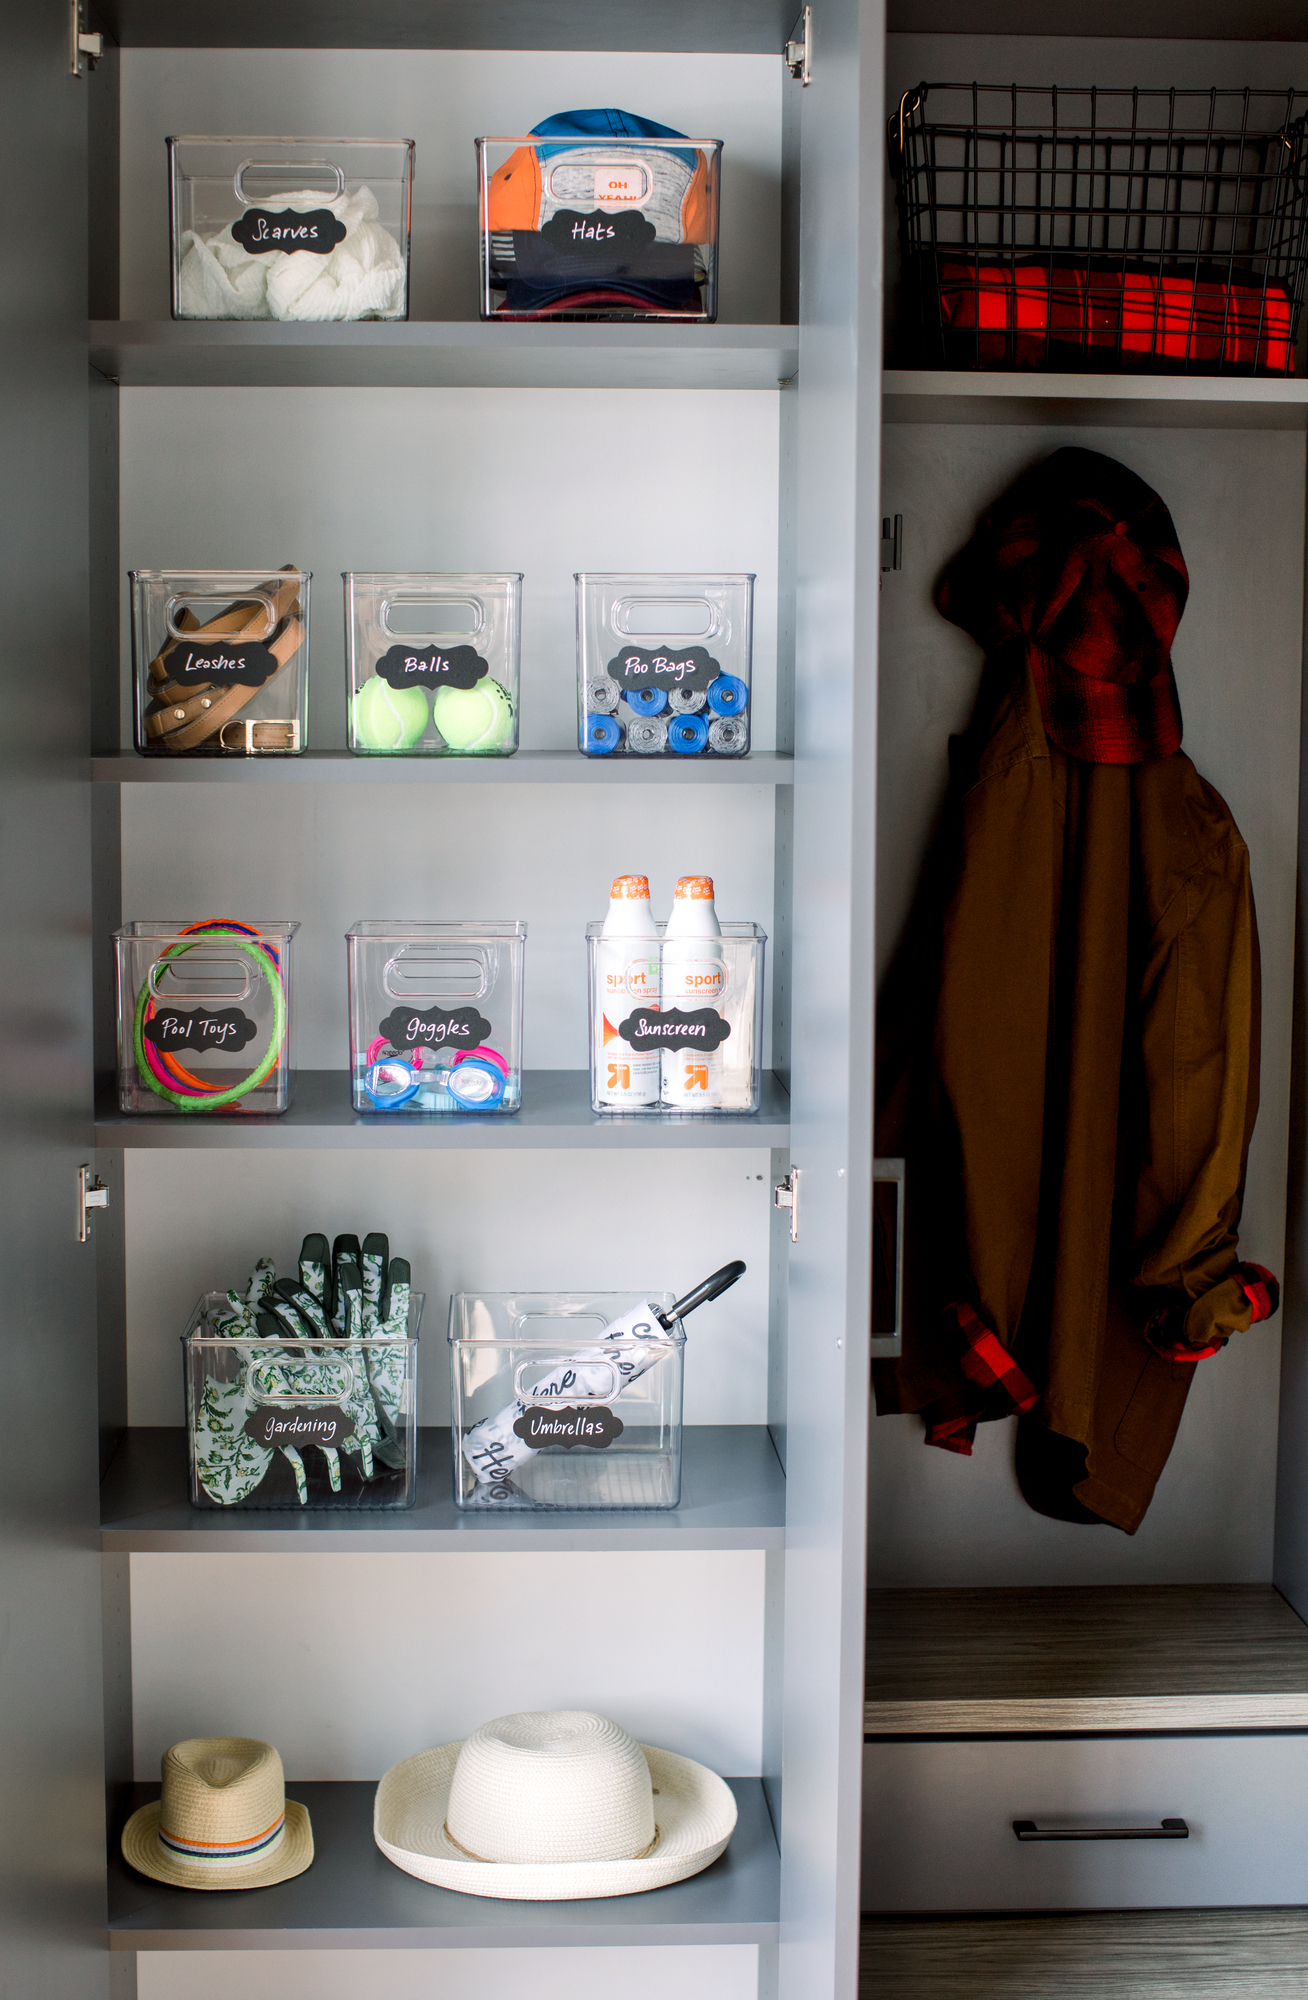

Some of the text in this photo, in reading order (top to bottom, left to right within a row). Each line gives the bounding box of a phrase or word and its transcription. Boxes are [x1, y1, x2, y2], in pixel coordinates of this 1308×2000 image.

[608, 181, 628, 189] OH
[252, 219, 319, 241] Scarves
[571, 220, 616, 241] Hats
[185, 653, 246, 672] Leashes
[404, 656, 450, 673] Balls
[625, 656, 696, 681] Poo Bags
[684, 972, 722, 988] sport
[162, 1017, 237, 1044] Pool Toys
[634, 1018, 706, 1037] Sunscreen
[531, 1416, 604, 1437] Umbrellas
